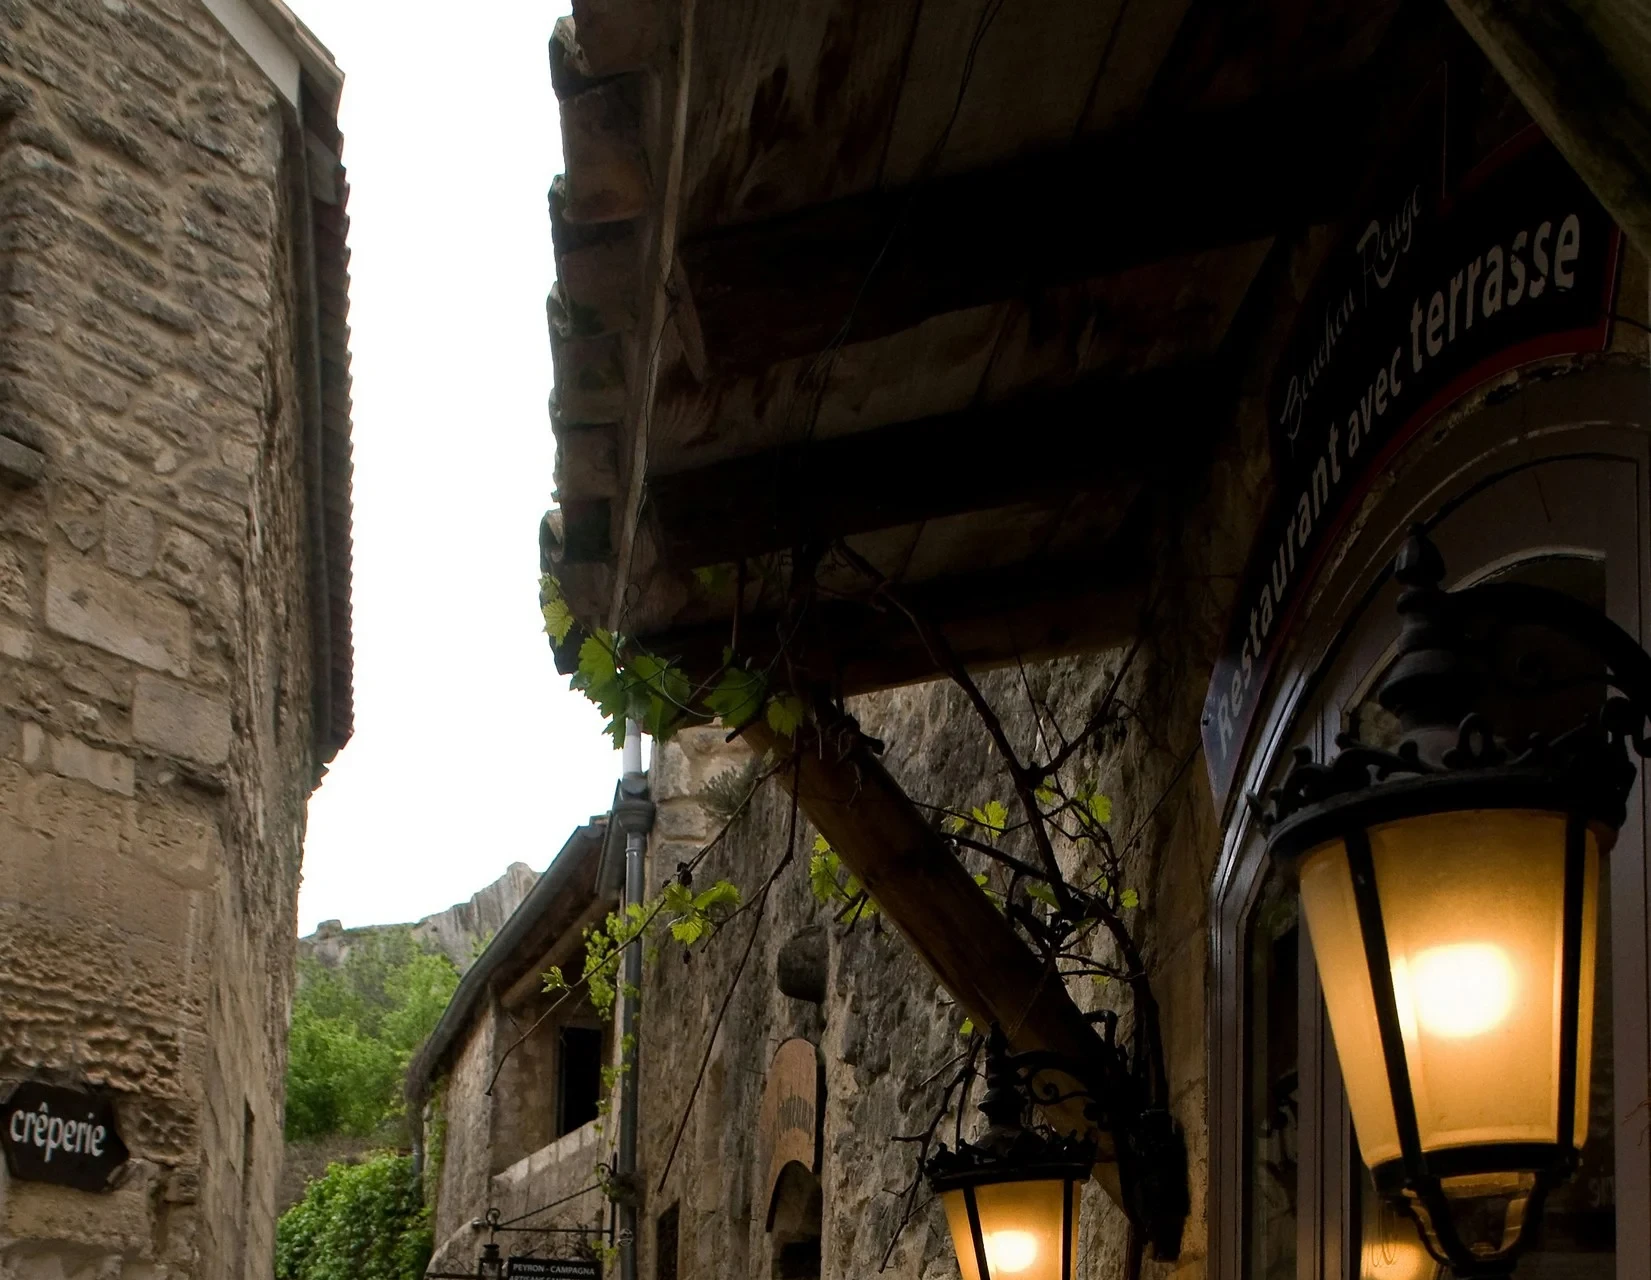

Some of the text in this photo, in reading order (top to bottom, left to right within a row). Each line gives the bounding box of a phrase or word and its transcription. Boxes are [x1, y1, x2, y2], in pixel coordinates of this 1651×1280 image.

[1356, 184, 1422, 308] Rouge
[1216, 212, 1581, 760] Restaurant avec terrasse
[9, 1101, 106, 1163] crêperie
[513, 1263, 544, 1273] PEYRON
[550, 1265, 596, 1275] CAMPAGNA
